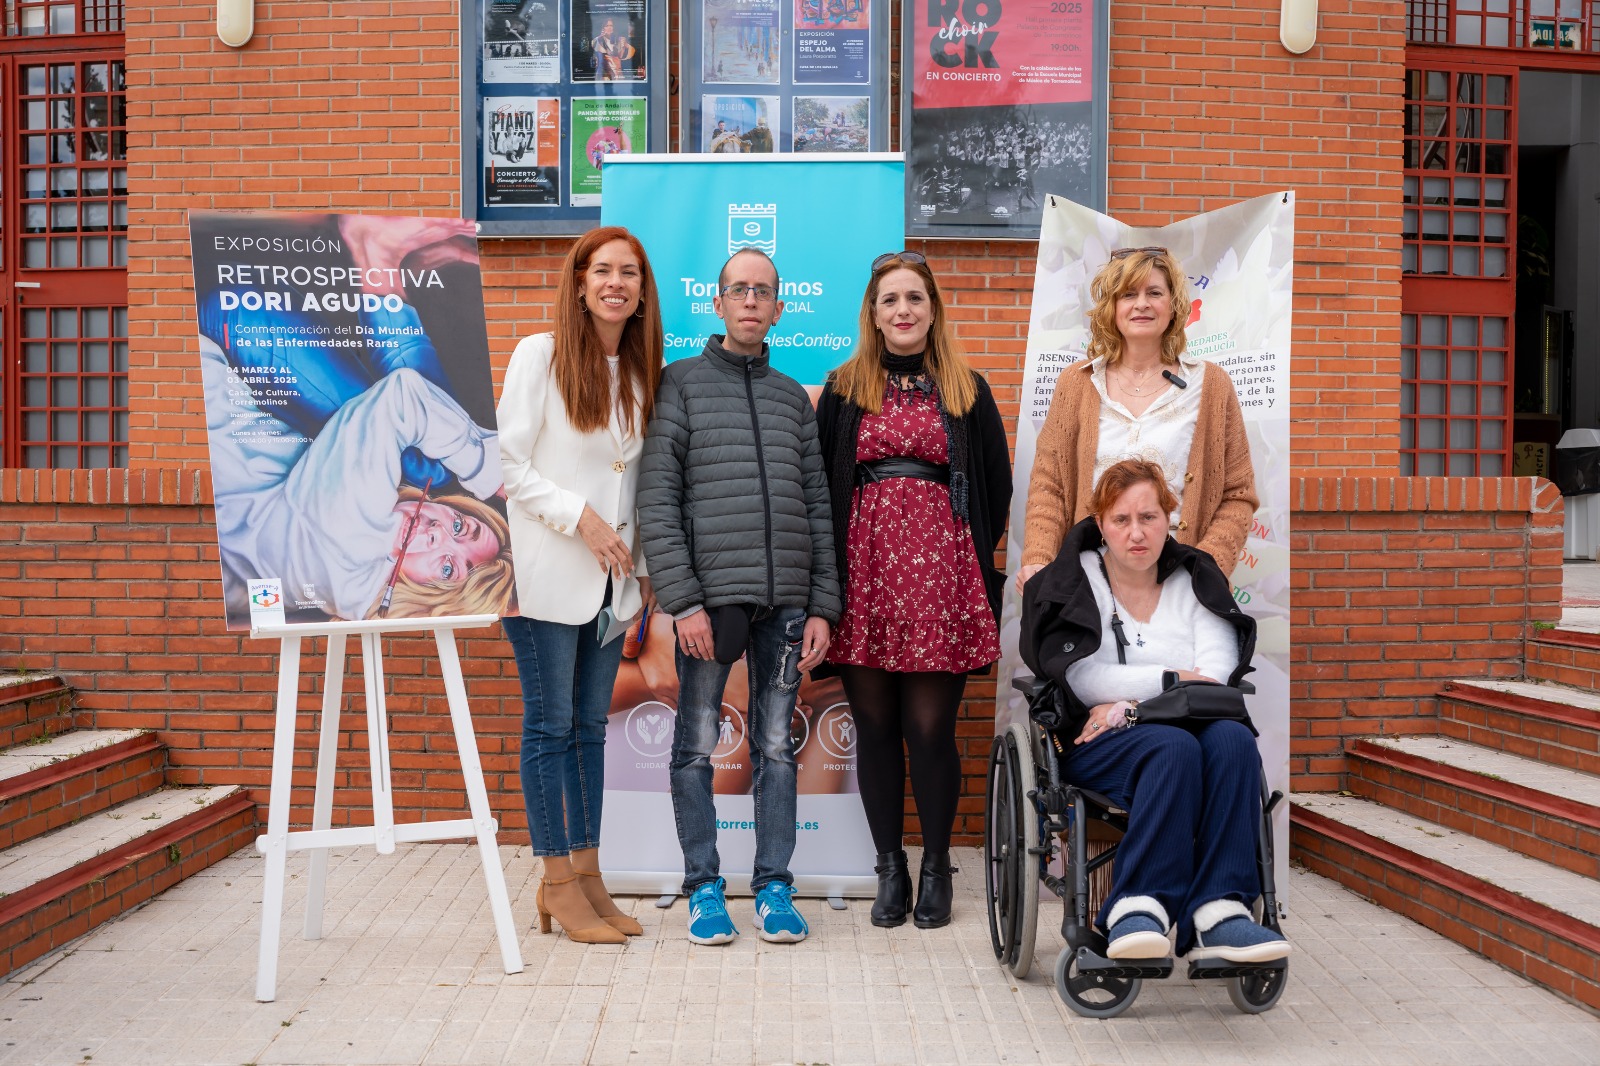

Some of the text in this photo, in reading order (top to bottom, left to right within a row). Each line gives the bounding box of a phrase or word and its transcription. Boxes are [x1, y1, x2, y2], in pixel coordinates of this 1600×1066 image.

[1050, 2, 1082, 14] 2025
[938, 17, 989, 40] choir
[930, 31, 1000, 68] CK
[926, 72, 1002, 82] EN CONCIERTO
[492, 112, 534, 131] PIANO
[214, 236, 341, 253] EXPOSICIÓN
[218, 264, 445, 288] RETROSPECTIVA
[680, 278, 823, 297] Torinos
[219, 291, 404, 313] DORI AGUDO
[235, 324, 423, 335] Conmemoración del Día Mundial
[236, 338, 399, 348] de las Enfermedades Raras
[1187, 332, 1228, 348] MEDADES
[1187, 340, 1235, 357] NDALUCÍA
[1259, 352, 1275, 361] sin
[1228, 364, 1276, 376] ersonas
[1035, 386, 1054, 395] fam
[1247, 387, 1260, 395] de
[1265, 386, 1275, 394] la
[1268, 398, 1275, 408] y
[1032, 408, 1048, 417] act
